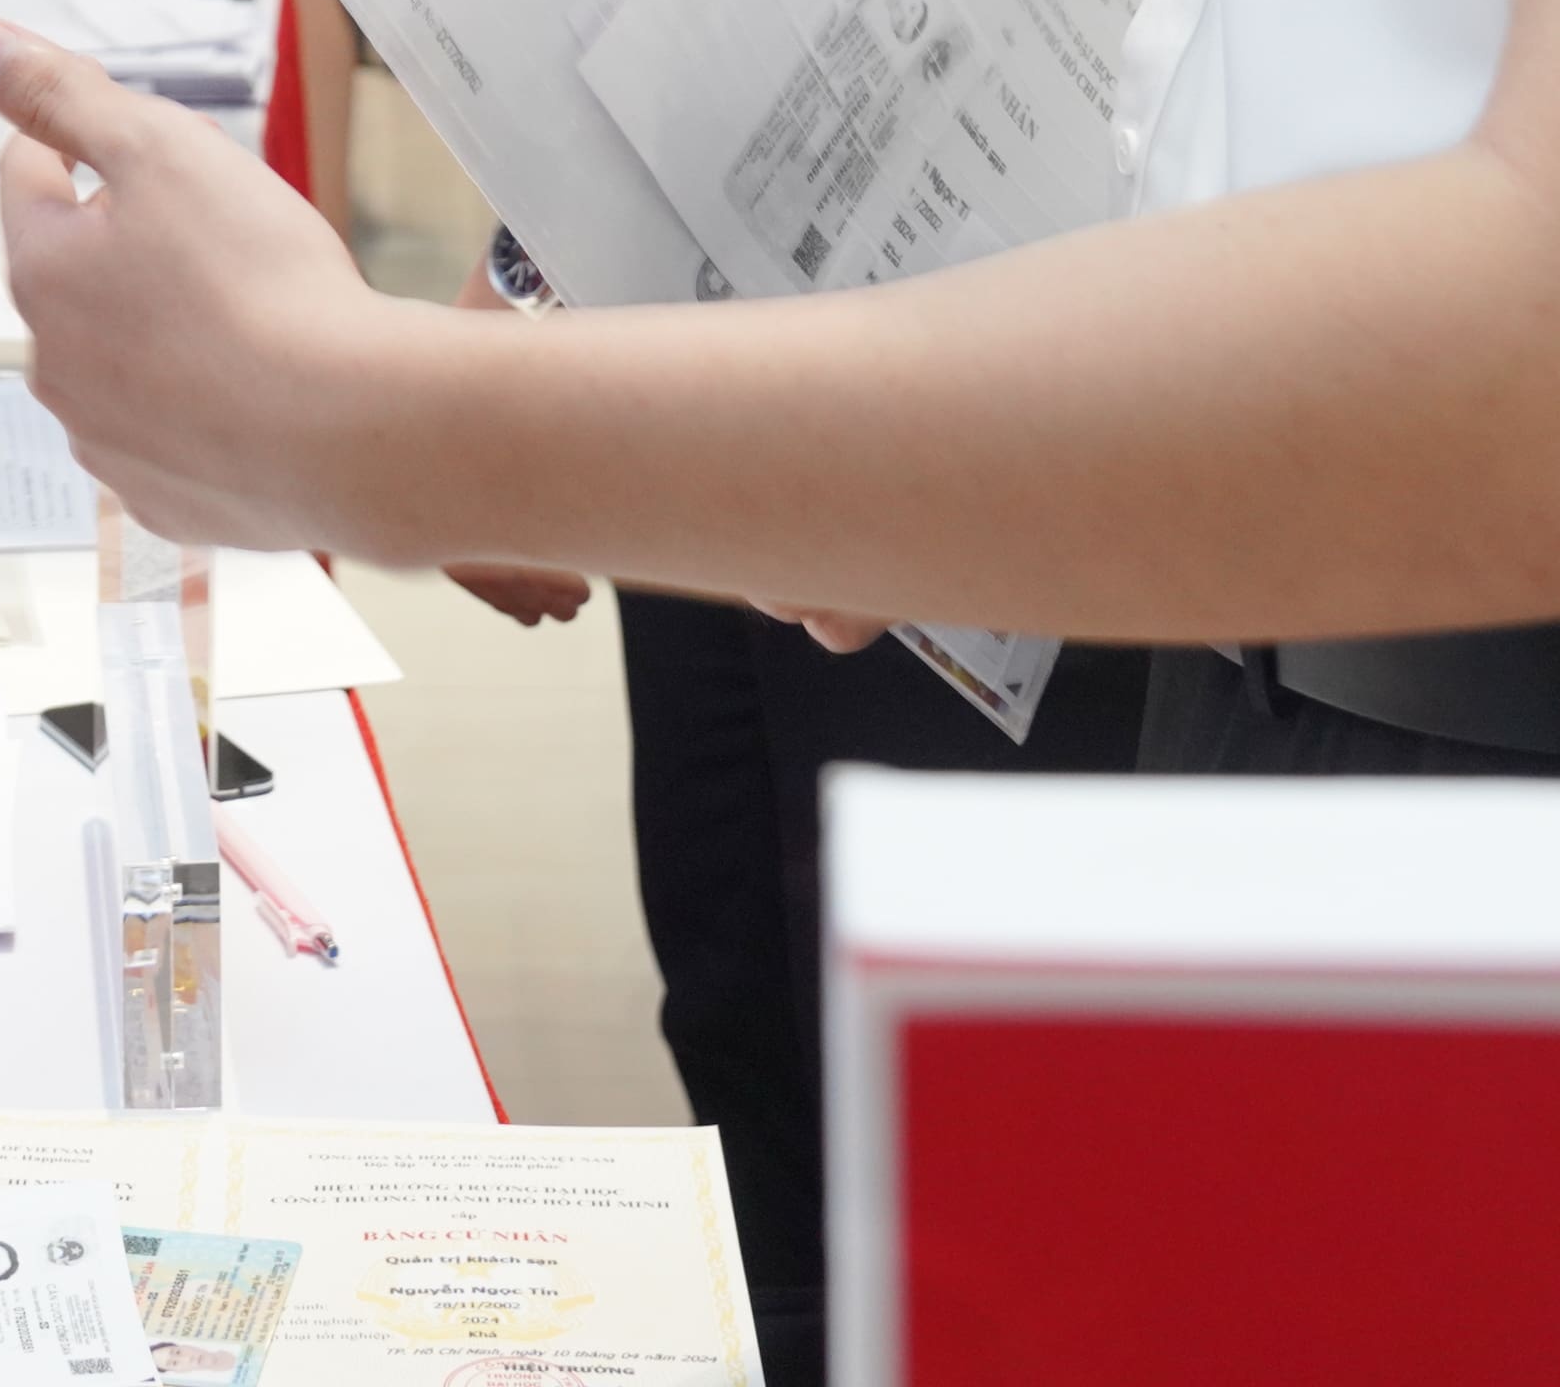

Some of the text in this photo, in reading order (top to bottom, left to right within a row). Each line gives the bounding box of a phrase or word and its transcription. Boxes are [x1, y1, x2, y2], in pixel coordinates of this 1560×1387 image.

[492, 1229, 568, 1244] NHÂN
[389, 1284, 465, 1296] Nguyễn
[471, 1286, 523, 1296] Ngọc
[461, 1316, 500, 1324] 2024
